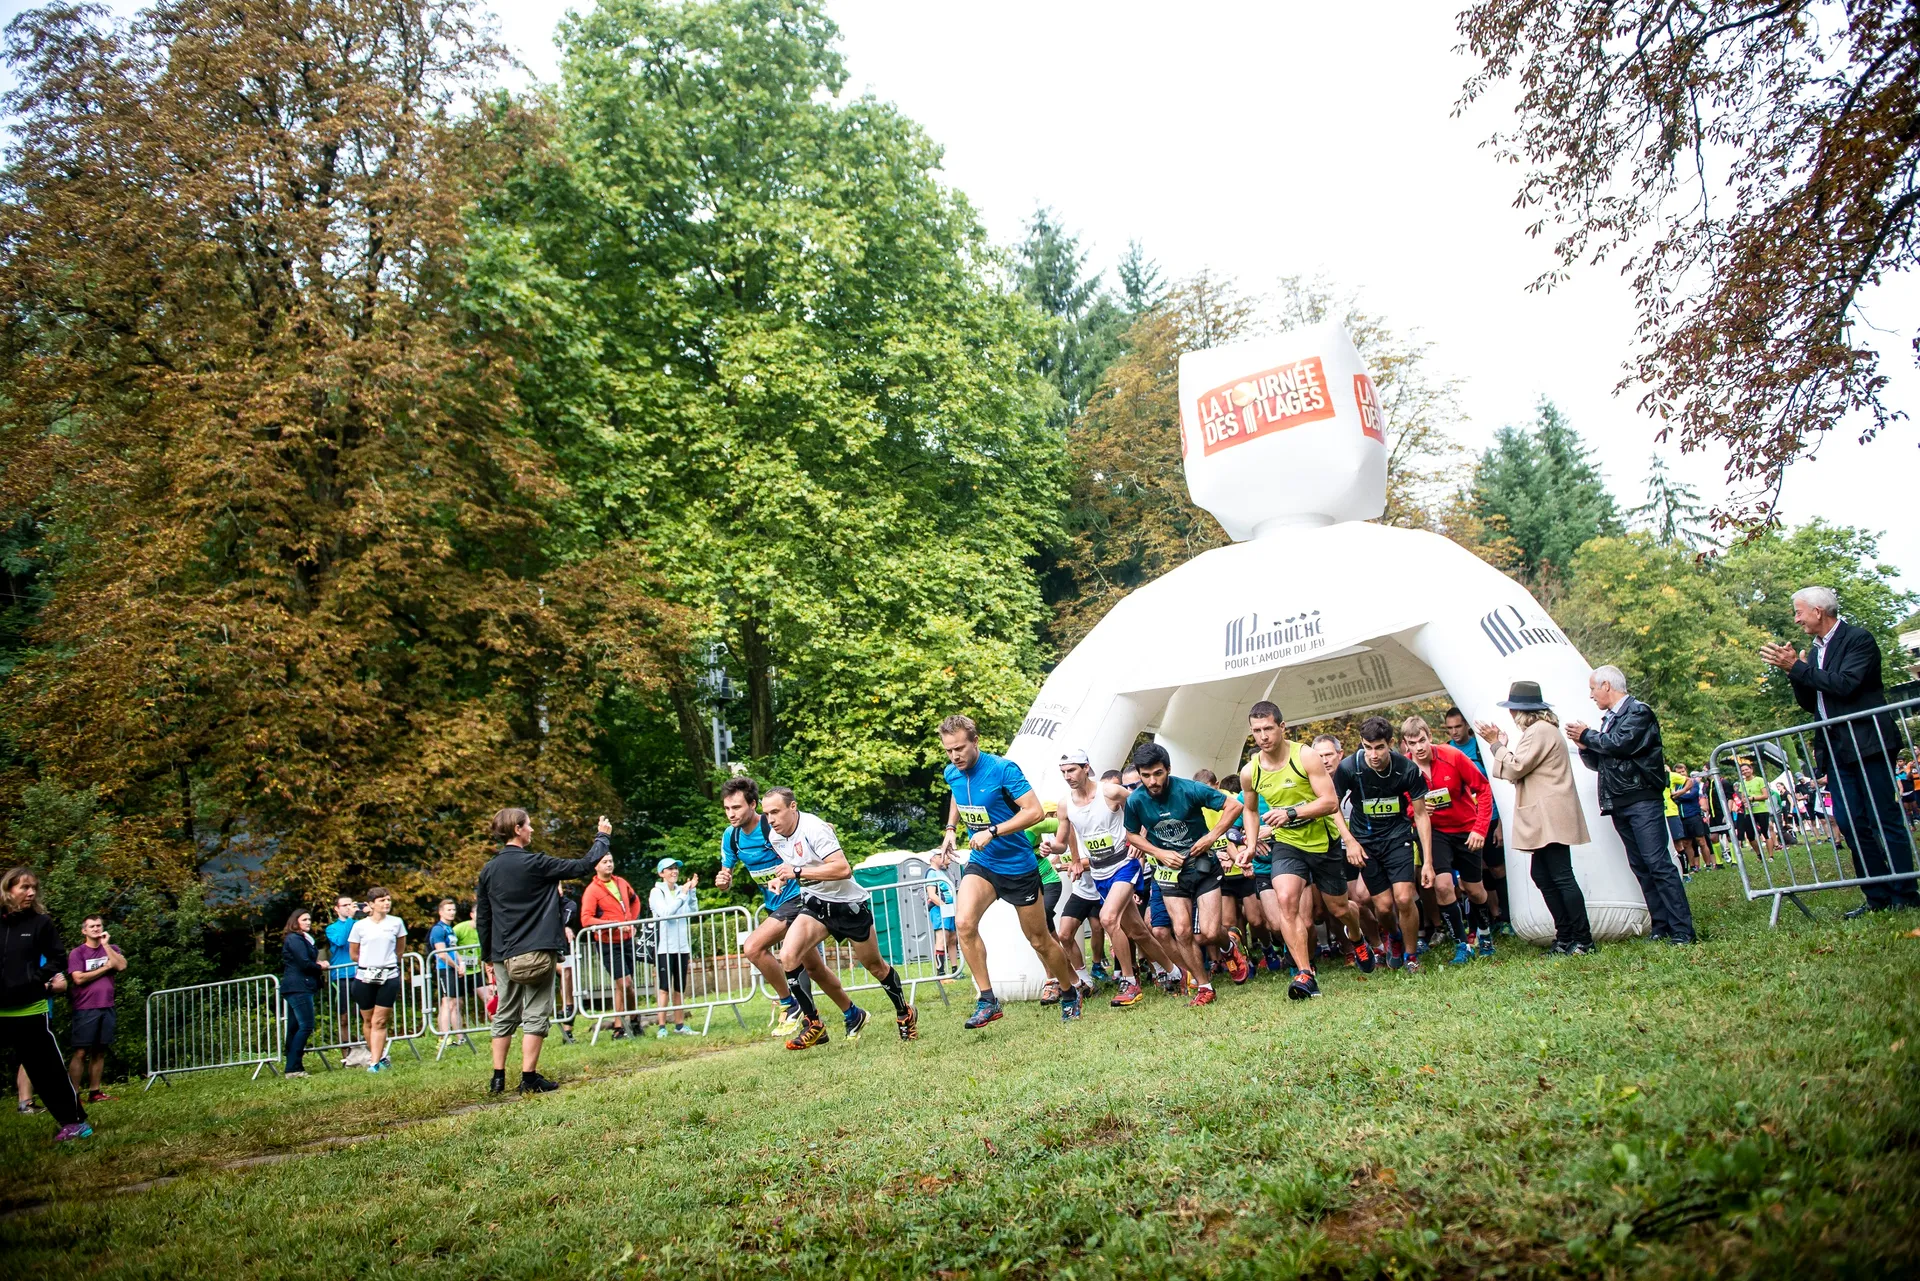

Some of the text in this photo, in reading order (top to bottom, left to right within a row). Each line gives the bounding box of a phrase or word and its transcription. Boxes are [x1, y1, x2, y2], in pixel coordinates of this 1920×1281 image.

[1201, 361, 1320, 424] LA TOURNÉE
[1357, 381, 1373, 405] LA
[1205, 414, 1240, 446] DES
[1362, 405, 1381, 432] DES
[1225, 638, 1325, 671] POUR L'AMOUR DU JEU
[965, 813, 984, 823] 194
[1371, 804, 1393, 812] 119
[1087, 838, 1107, 850] 204
[1159, 871, 1173, 881] 187
